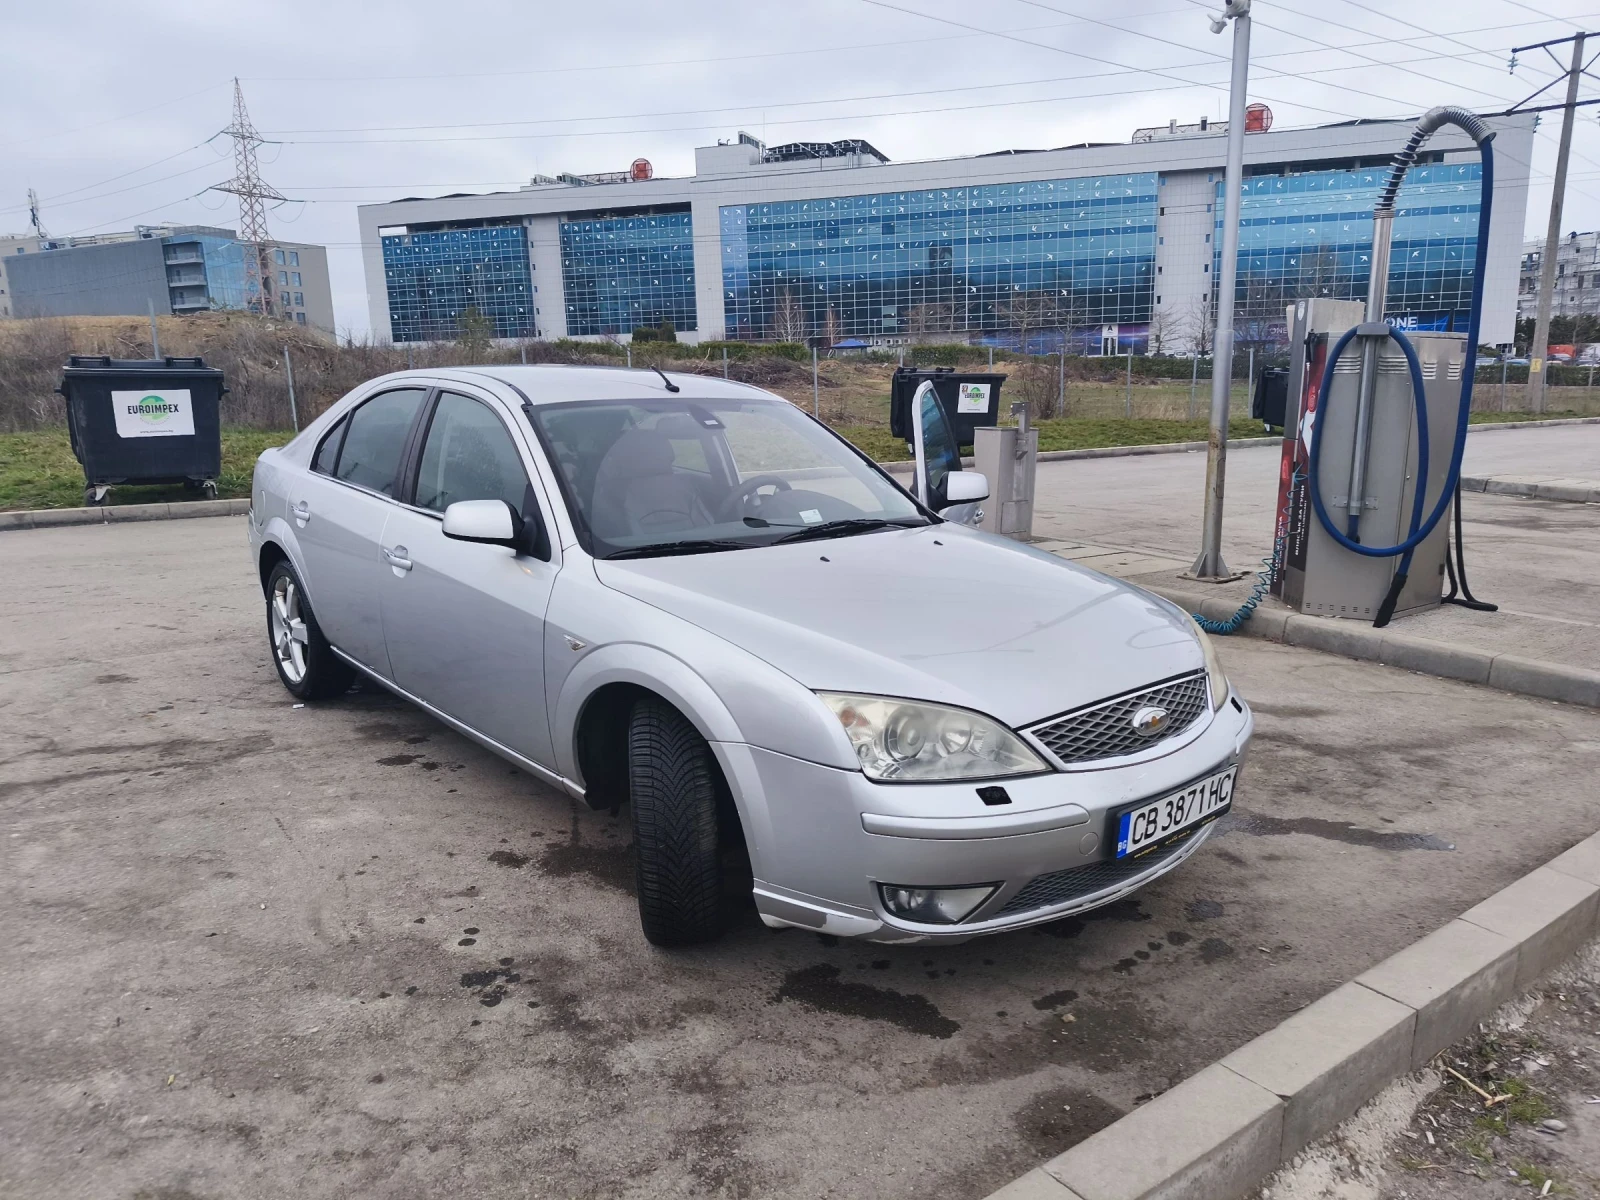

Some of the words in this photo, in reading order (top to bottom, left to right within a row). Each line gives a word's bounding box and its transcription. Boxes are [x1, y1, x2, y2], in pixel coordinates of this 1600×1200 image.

[1384, 316, 1417, 328] ONE
[127, 404, 179, 414] EUROIMPEX
[1132, 806, 1159, 845] CB
[1161, 784, 1206, 832] 3871
[1207, 773, 1231, 810] HC
[1117, 840, 1127, 852] BG
